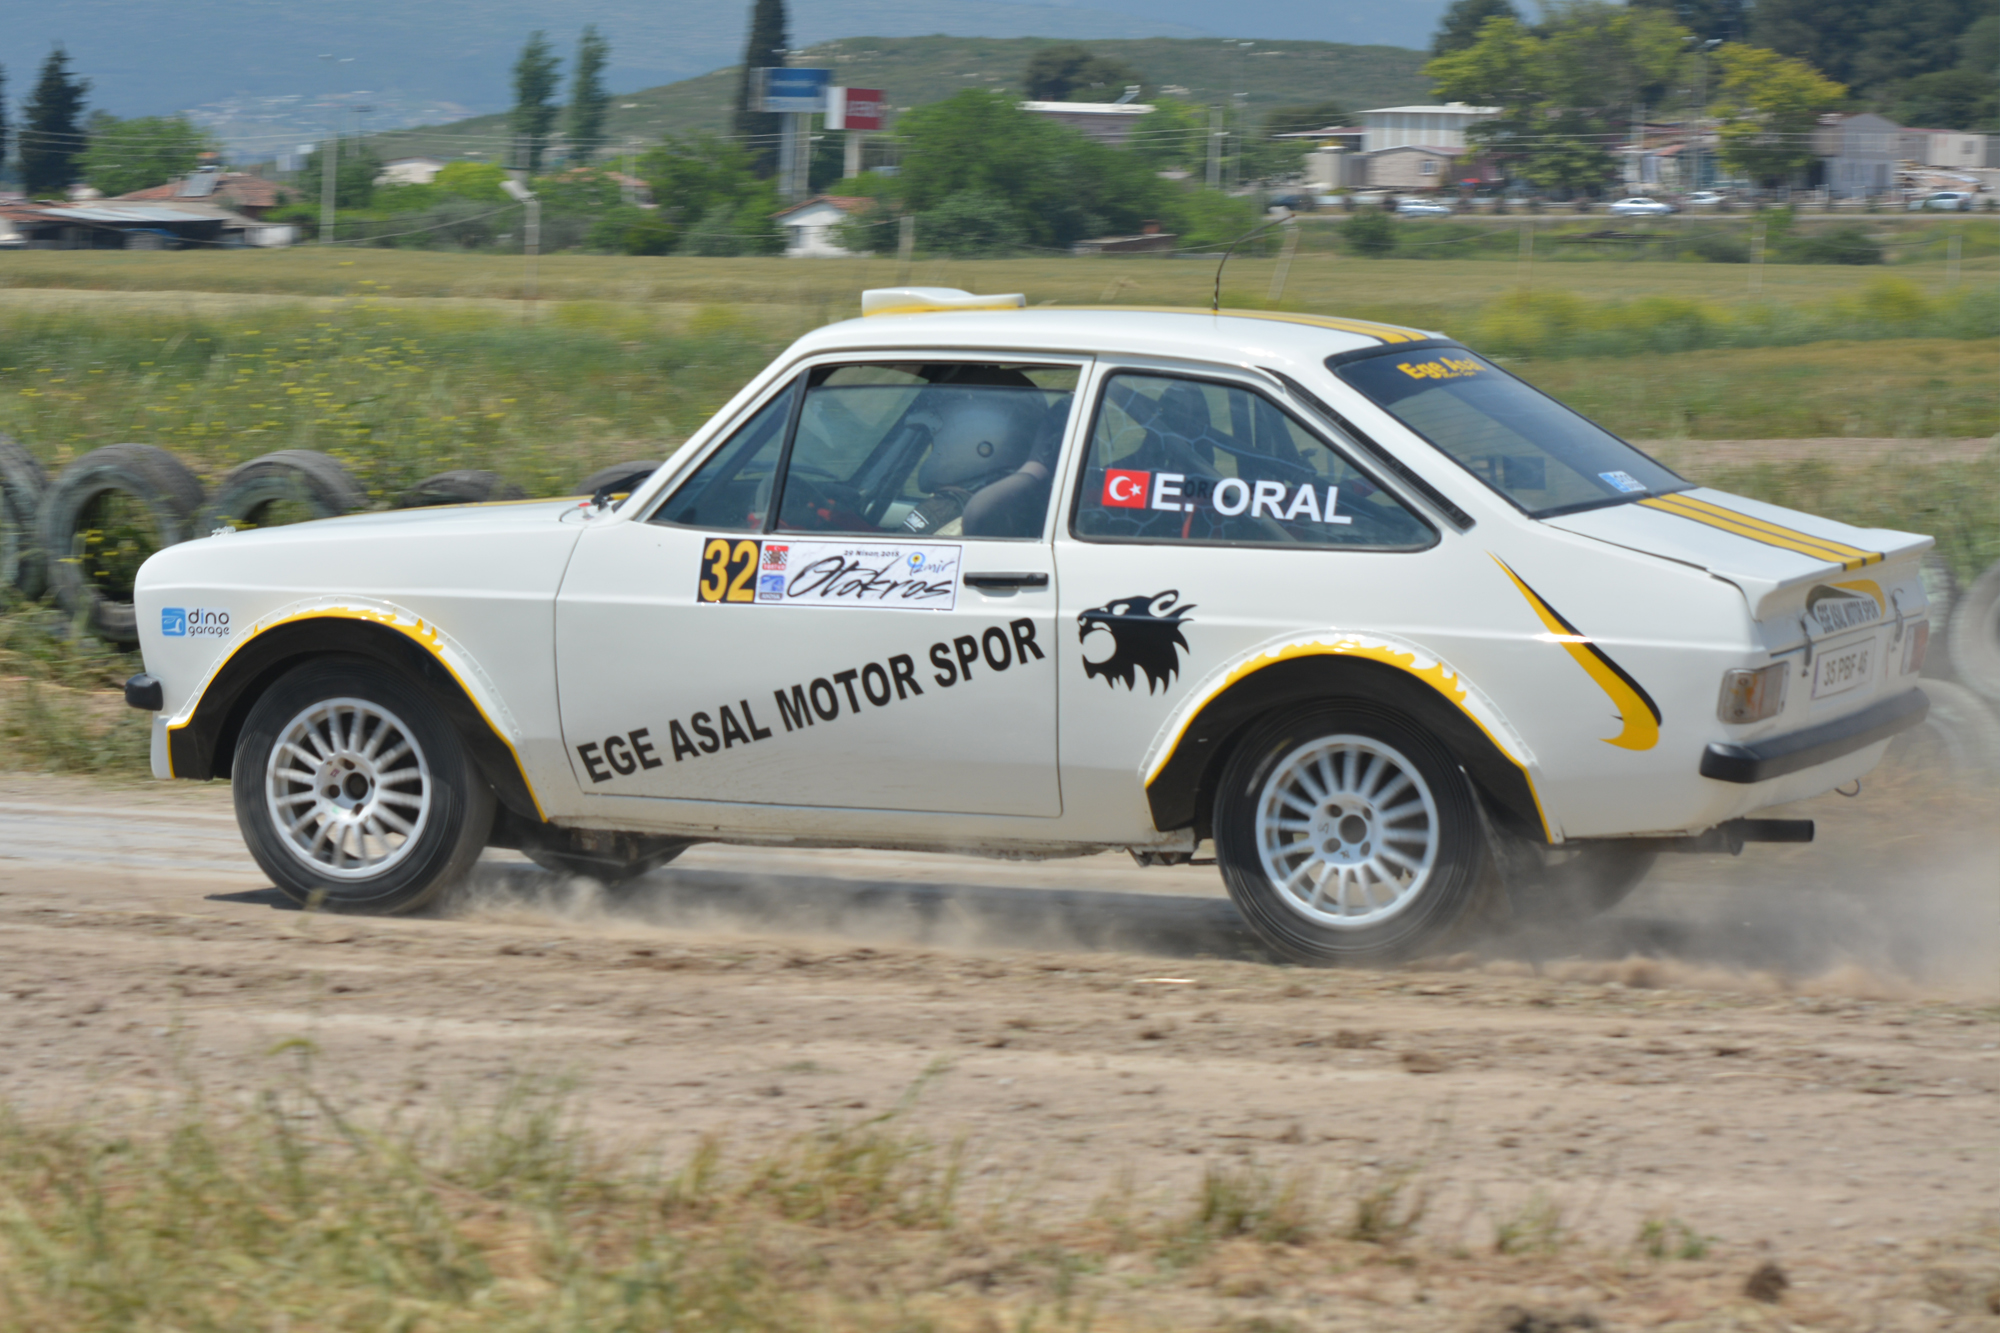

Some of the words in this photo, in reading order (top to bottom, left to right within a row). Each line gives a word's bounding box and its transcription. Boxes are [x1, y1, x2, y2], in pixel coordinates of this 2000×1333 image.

[1396, 362, 1447, 379] Ege
[1151, 472, 1194, 512] E.
[1212, 478, 1352, 525] ORAL
[700, 539, 758, 602] 32
[188, 608, 230, 625] dino
[188, 626, 230, 637] garage
[576, 727, 663, 783] EGE
[668, 699, 772, 762] ASAL
[774, 653, 924, 732] MOTOR
[928, 617, 1045, 688] SPOR
